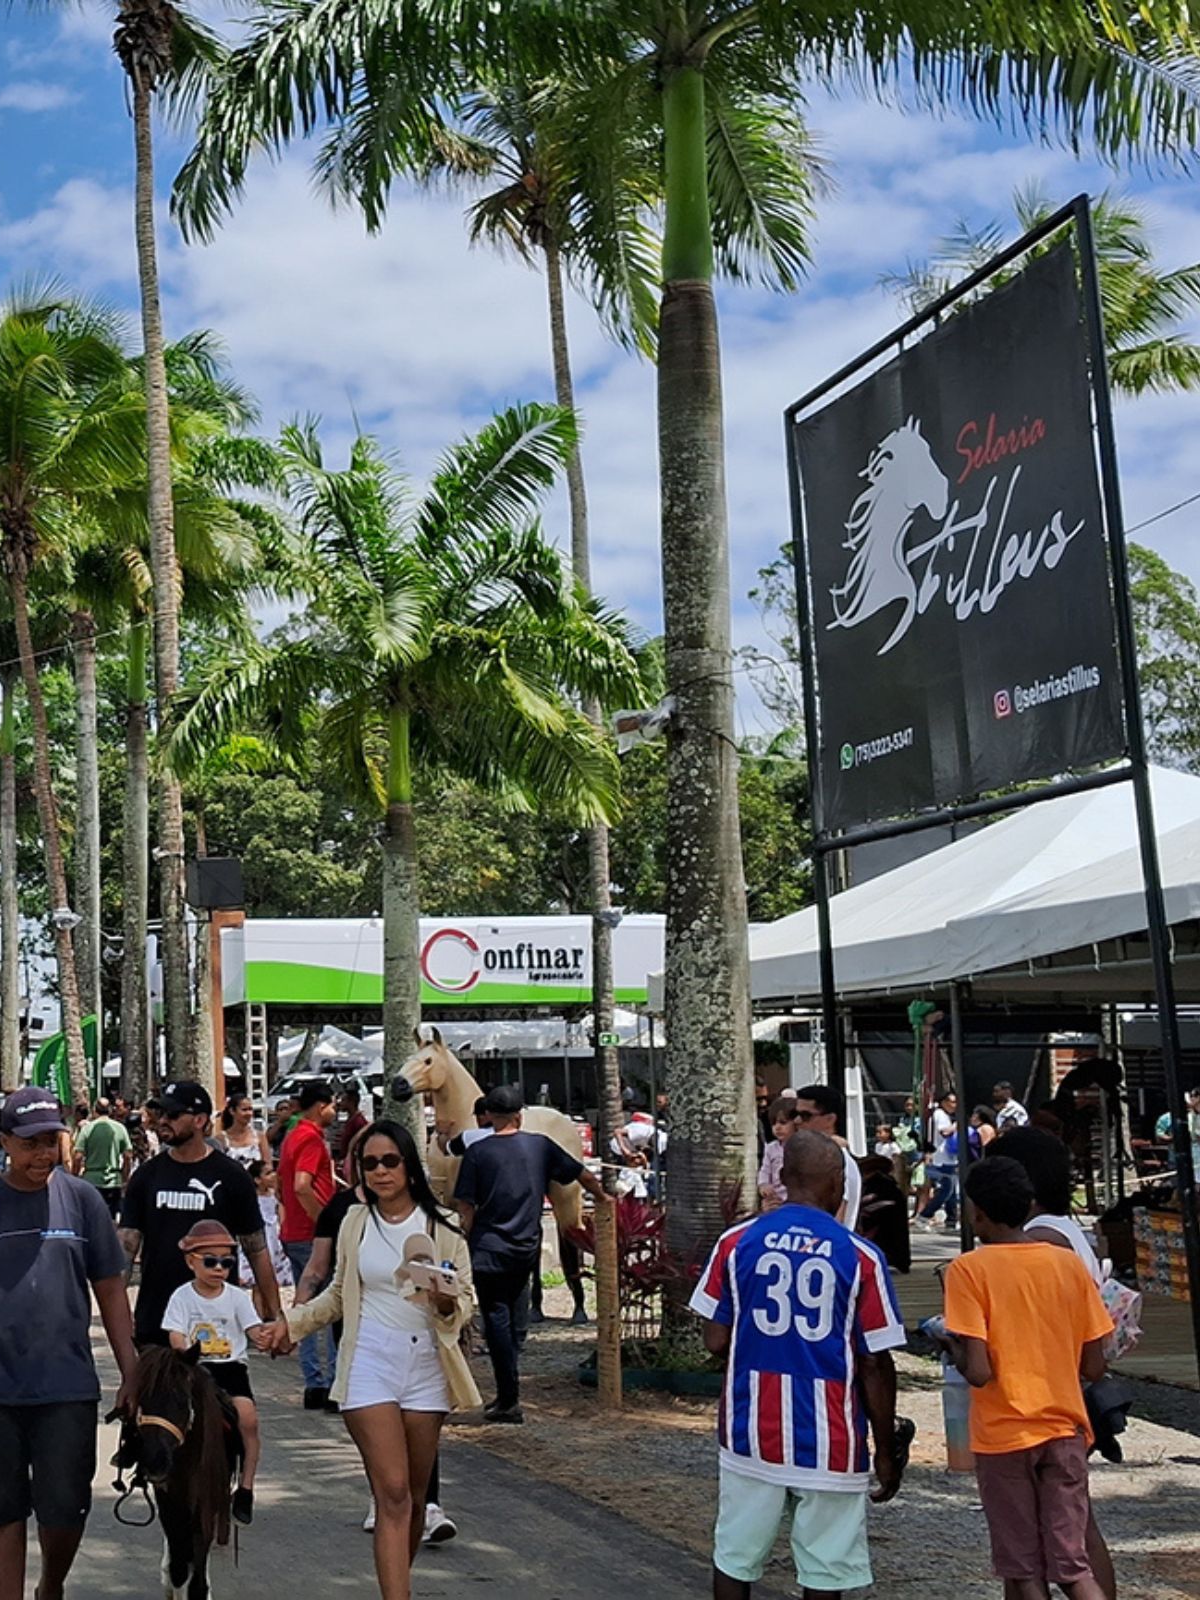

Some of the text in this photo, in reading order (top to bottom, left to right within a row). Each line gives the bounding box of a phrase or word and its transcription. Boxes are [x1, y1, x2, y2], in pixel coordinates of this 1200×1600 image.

[956, 411, 1047, 484] Selaria
[1013, 665, 1100, 713] @selariastillus
[156, 1191, 206, 1211] PUMA
[764, 1231, 833, 1258] CAIXA
[752, 1251, 837, 1343] 39
